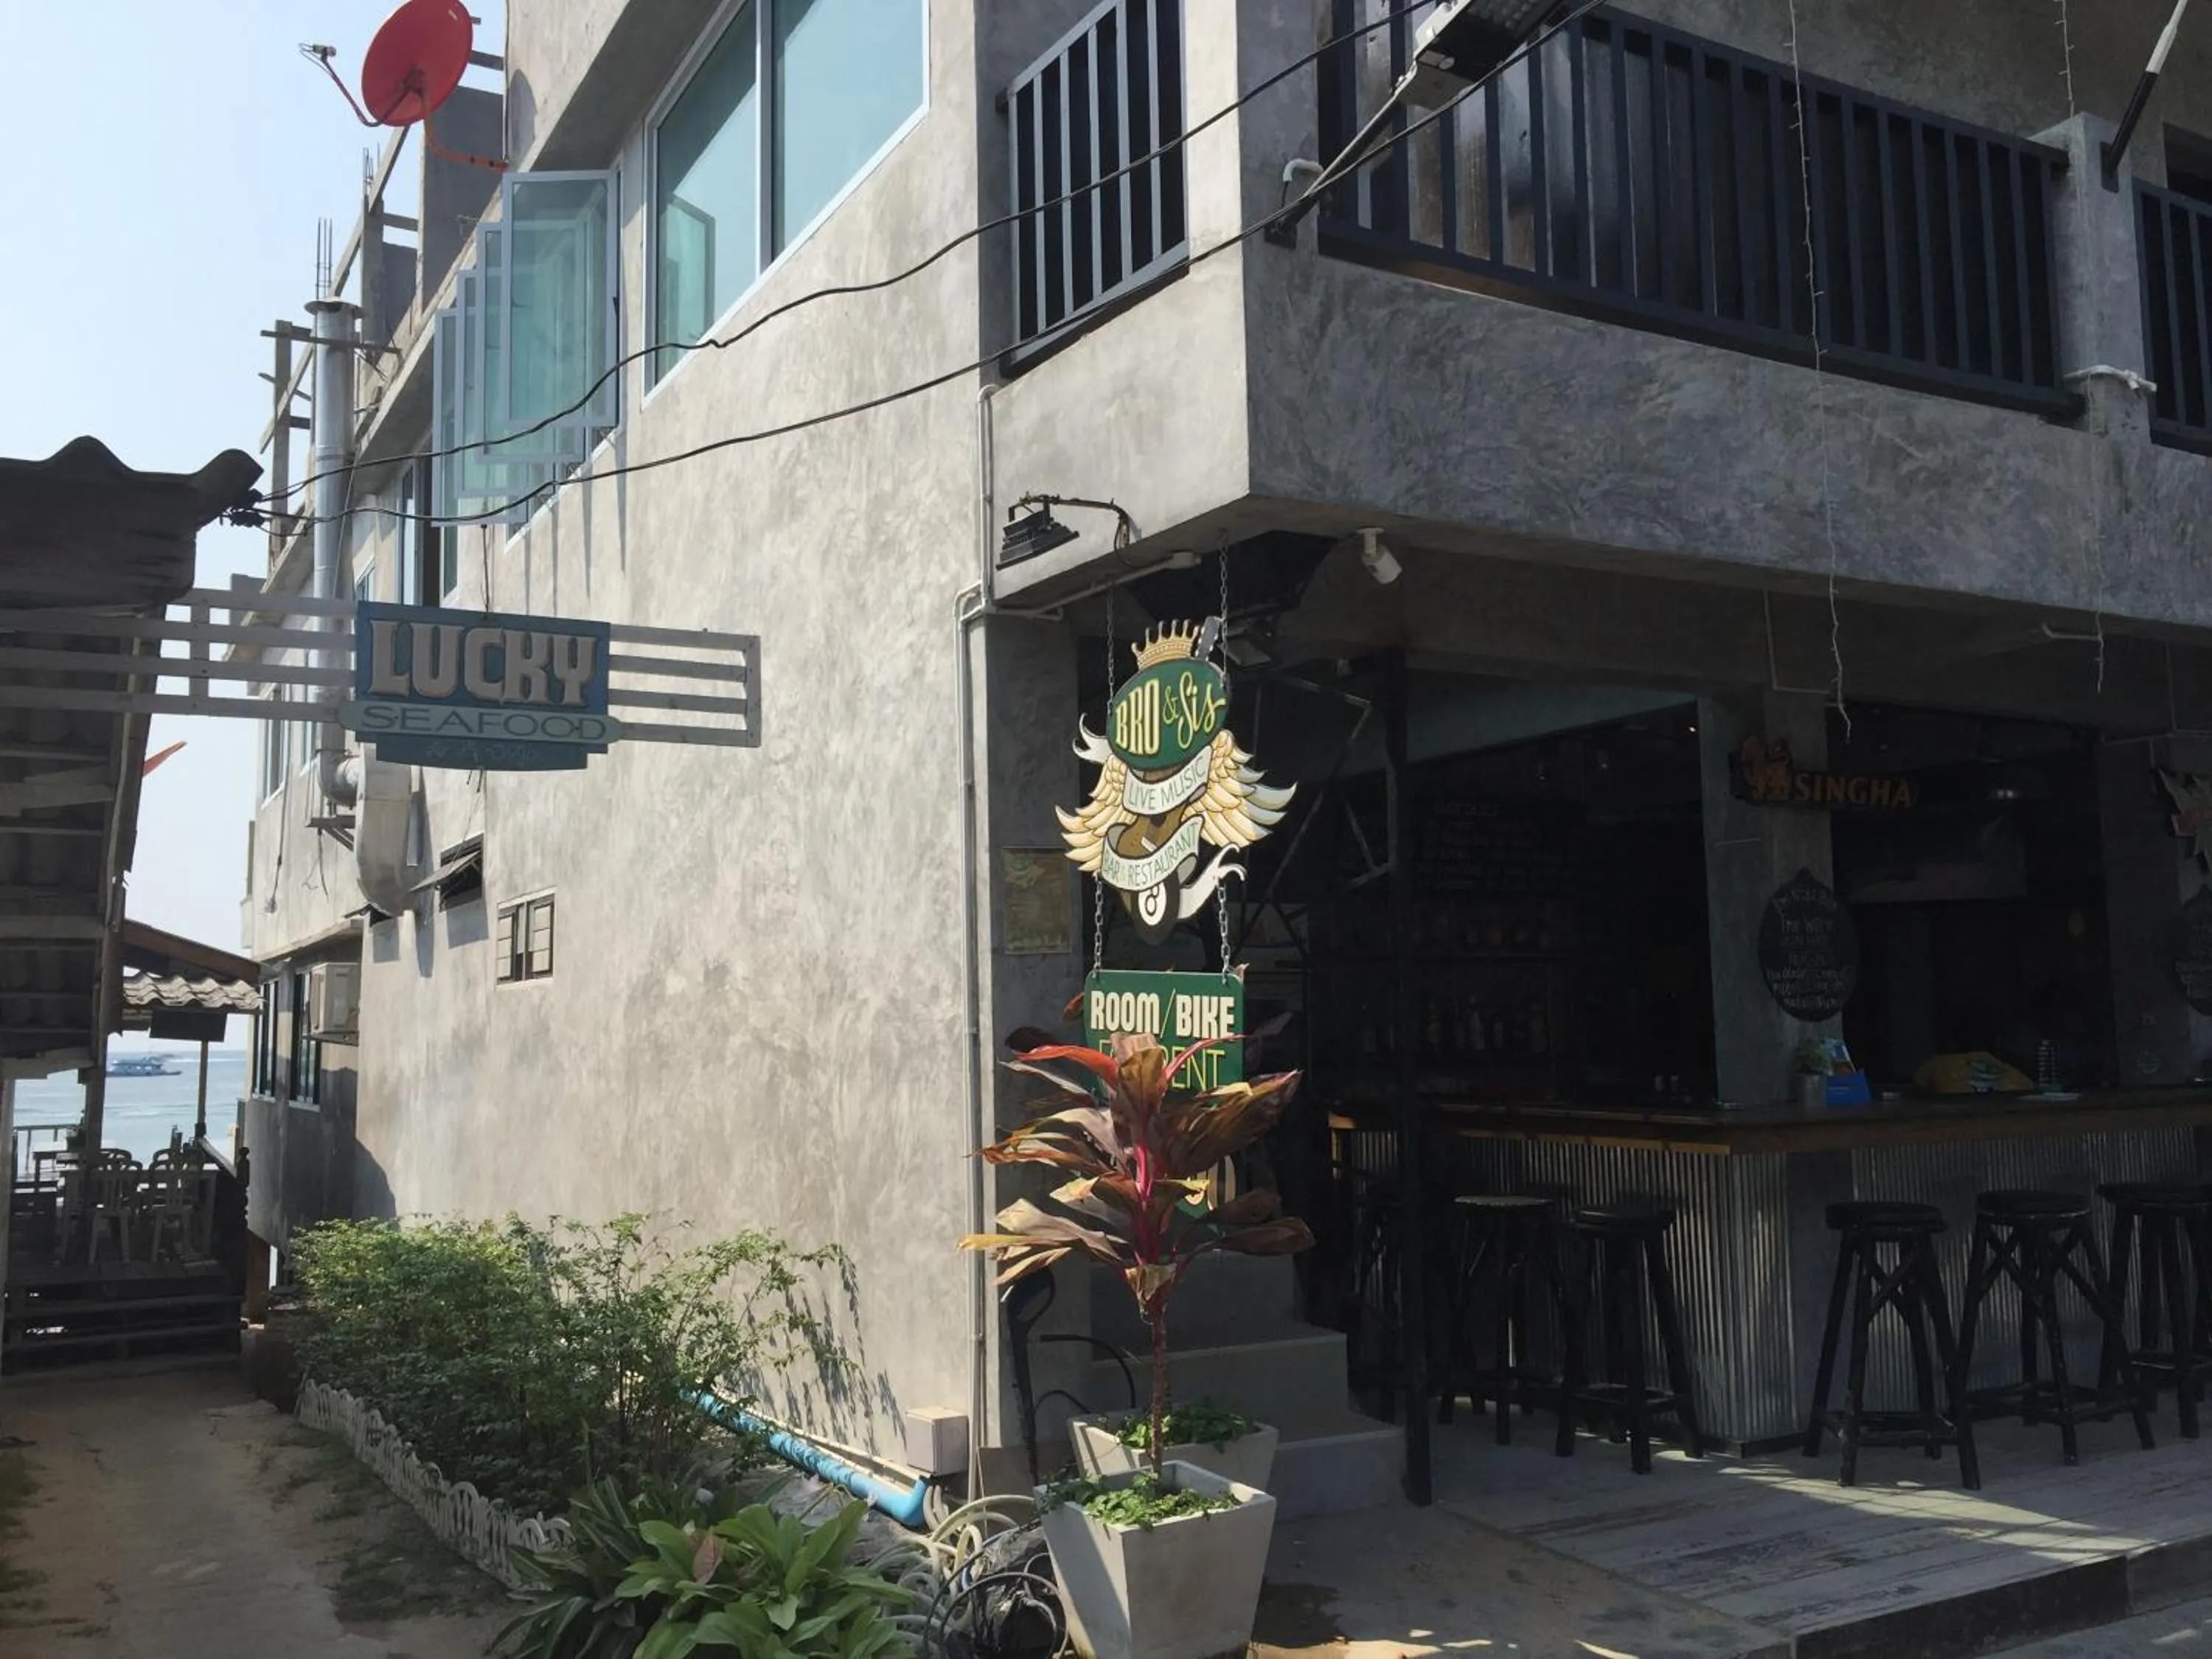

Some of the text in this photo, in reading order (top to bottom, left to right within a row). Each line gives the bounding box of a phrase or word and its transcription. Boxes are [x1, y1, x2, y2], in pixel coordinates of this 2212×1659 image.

[368, 619, 597, 706] LUCKY
[361, 706, 608, 739] SEAFOOD
[1116, 672, 1226, 756] BRO & Sis
[1128, 756, 1206, 810] LIVE MUSIC
[1795, 773, 1914, 808] SINGHA
[1104, 846, 1120, 882] BAR
[1127, 822, 1199, 887] RESTAURANT
[1160, 1044, 1225, 1092] ENT
